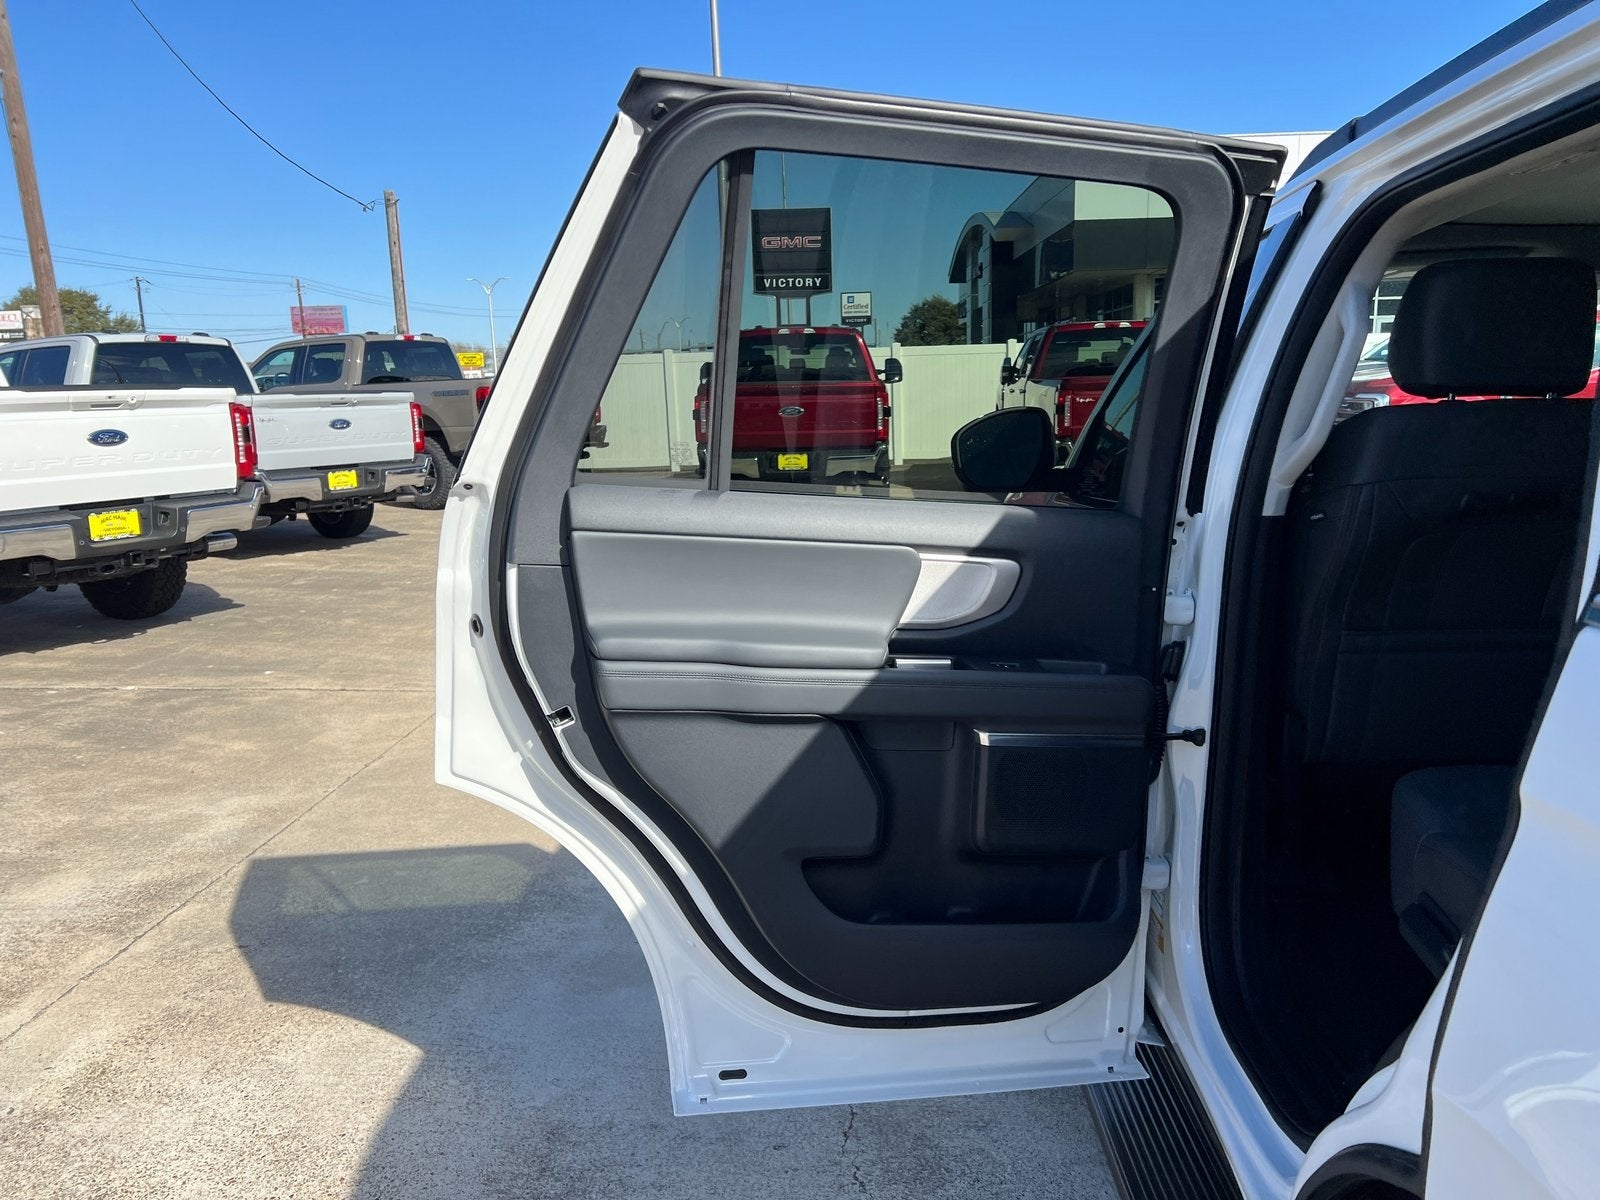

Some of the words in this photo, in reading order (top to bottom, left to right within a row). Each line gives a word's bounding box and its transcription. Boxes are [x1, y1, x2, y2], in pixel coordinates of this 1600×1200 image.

[761, 235, 822, 249] GMC
[763, 277, 822, 288] VICTORY
[843, 303, 869, 311] Certified
[0, 454, 122, 472] UPER
[132, 447, 224, 463] DUTY
